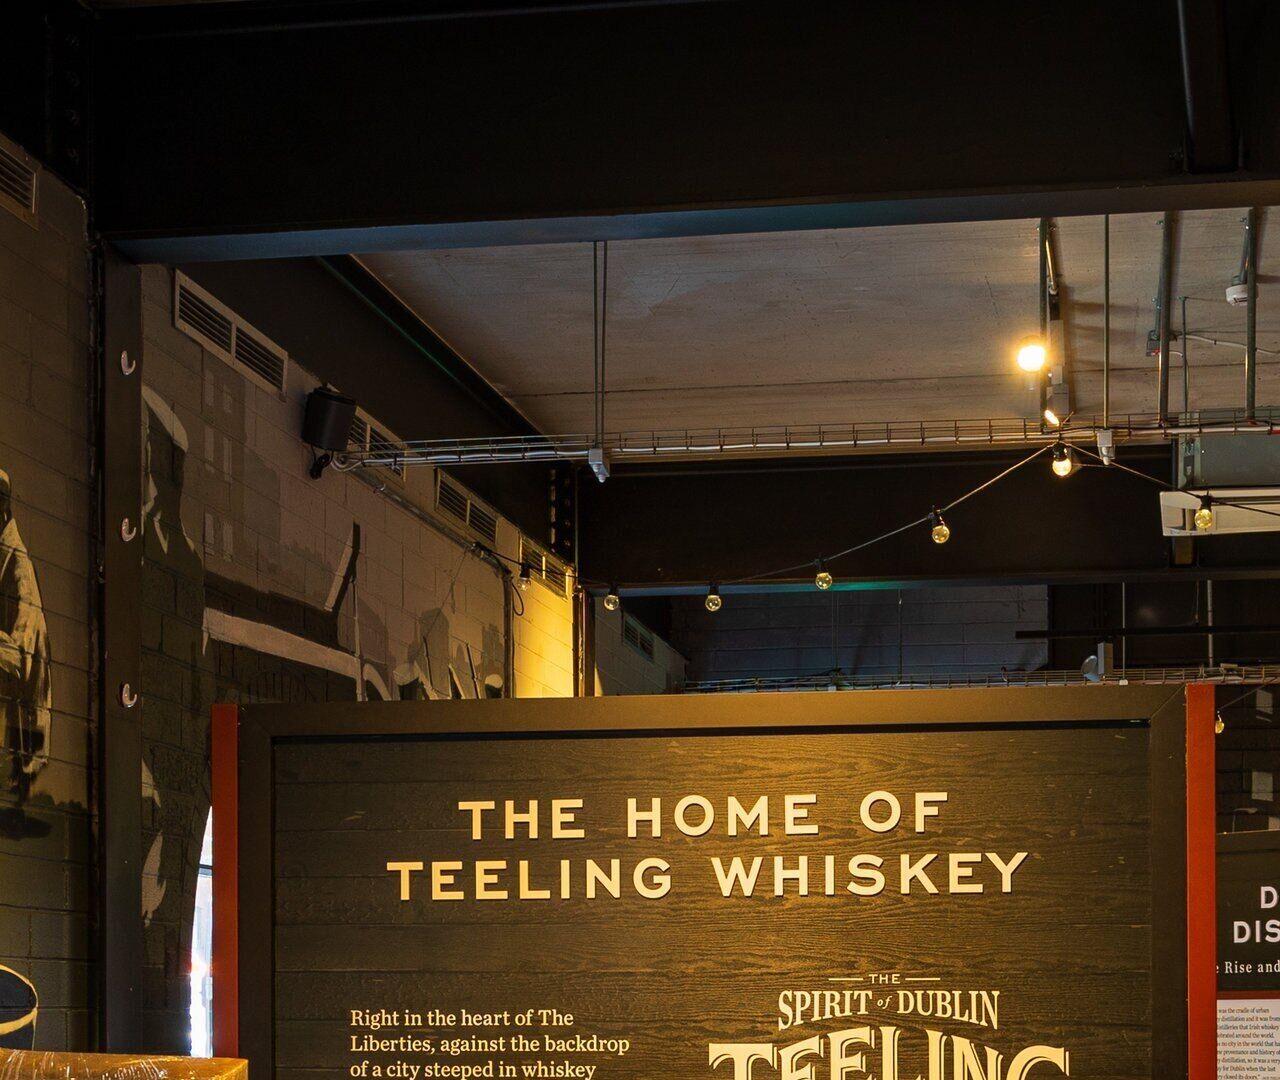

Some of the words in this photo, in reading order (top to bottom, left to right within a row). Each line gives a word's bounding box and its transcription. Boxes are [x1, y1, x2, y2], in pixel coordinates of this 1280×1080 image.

[458, 798, 585, 840] THE
[627, 793, 819, 838] HOME
[859, 790, 948, 833] OF
[386, 857, 671, 901] TEELING
[710, 851, 1028, 897] WHISKEY
[1224, 960, 1252, 974] Rise
[1257, 959, 1280, 973] and
[868, 973, 901, 984] THE
[350, 1009, 400, 1031] Right
[404, 1009, 423, 1026] in
[427, 1009, 456, 1026] the
[461, 1009, 511, 1026] heart
[514, 1008, 535, 1026] of
[537, 1008, 574, 1026] The
[778, 990, 873, 1032] SPIRIT
[876, 995, 893, 1010] of
[897, 990, 1000, 1030] DUBLIN
[350, 1034, 436, 1055] Liberties,
[440, 1034, 506, 1056] against
[510, 1034, 540, 1052] the
[544, 1034, 630, 1056] backdrop
[350, 1060, 370, 1077] of
[372, 1065, 382, 1077] a
[498, 1060, 517, 1077] in
